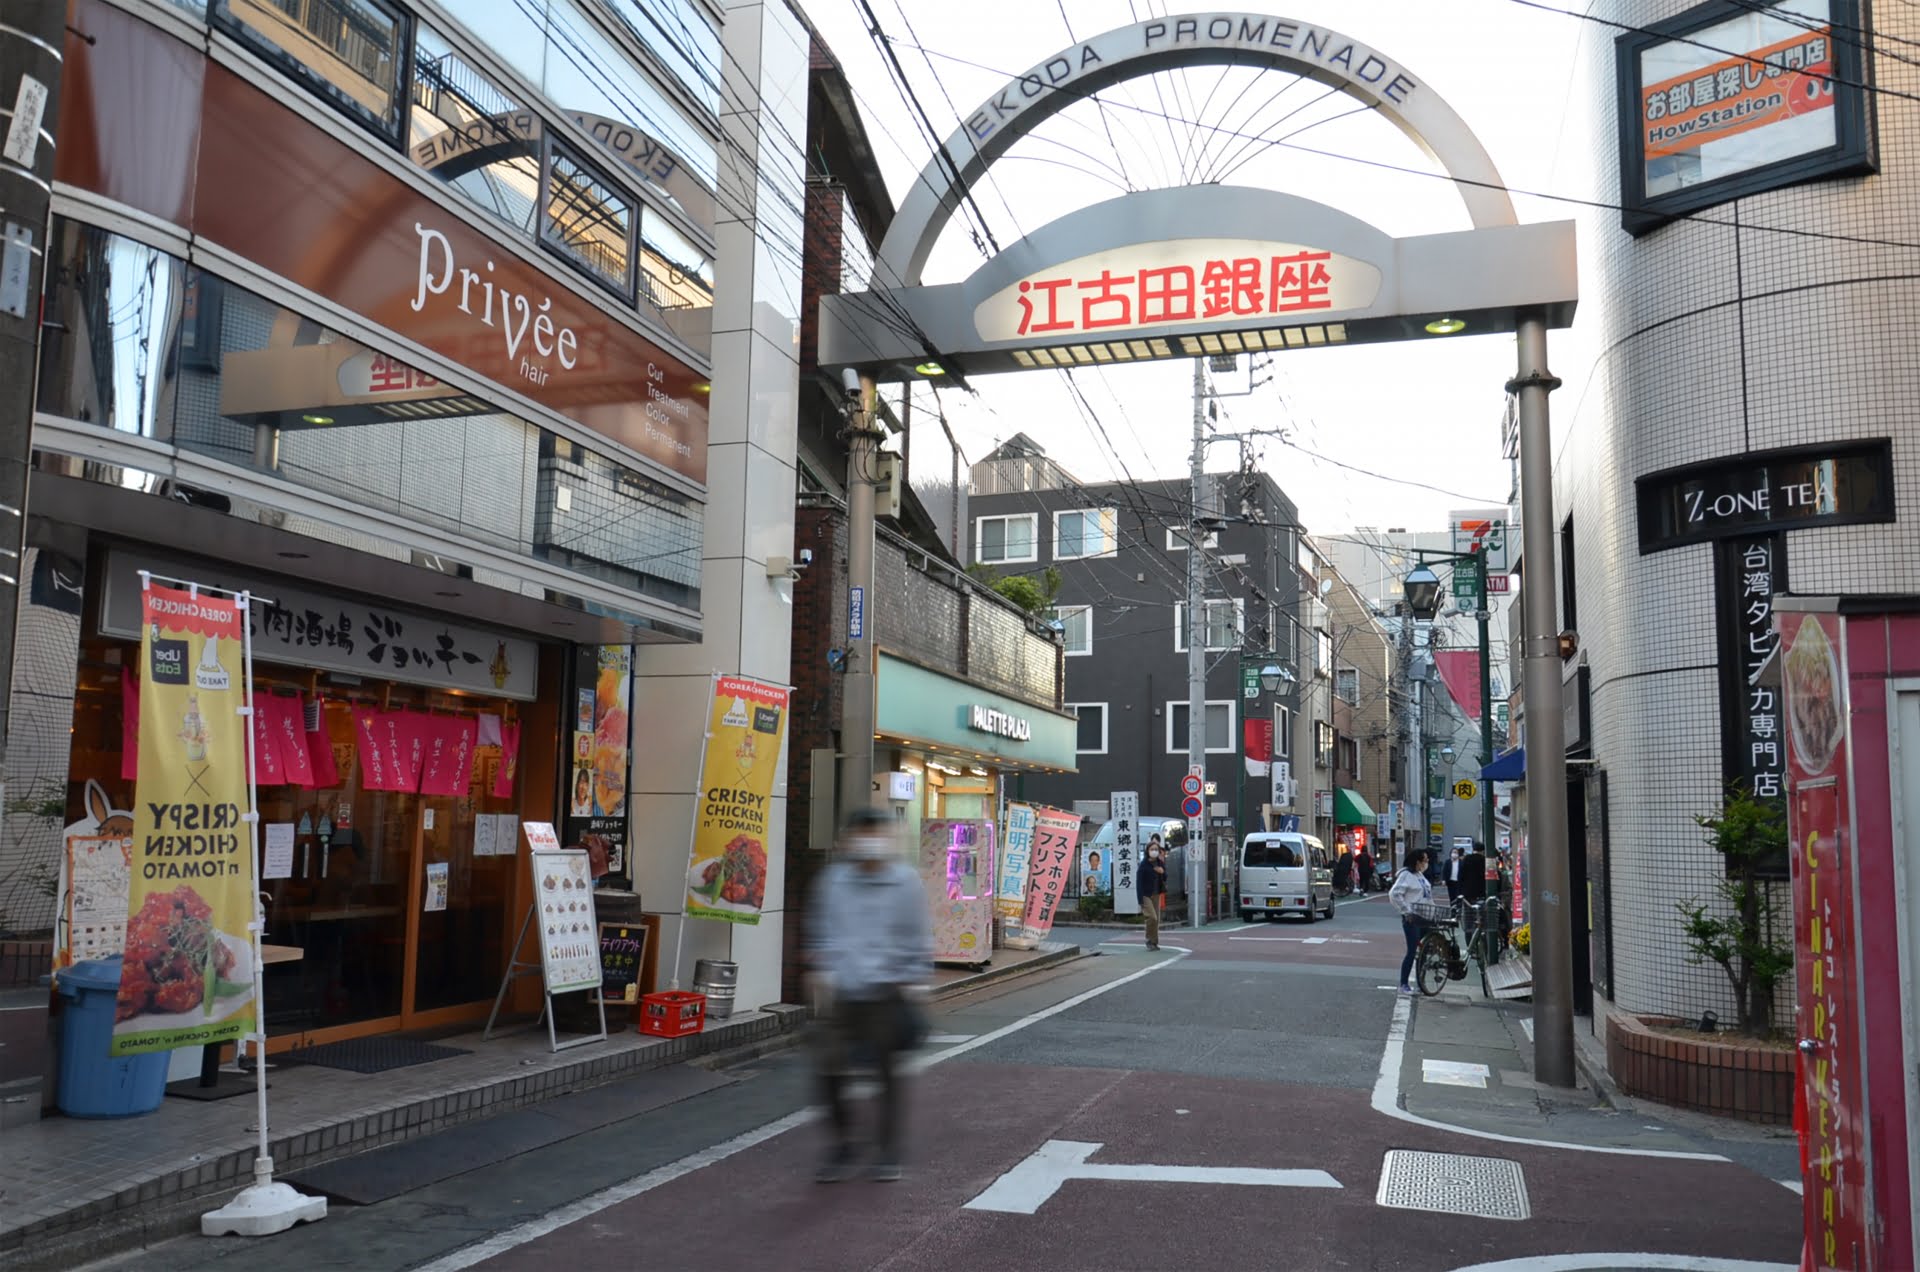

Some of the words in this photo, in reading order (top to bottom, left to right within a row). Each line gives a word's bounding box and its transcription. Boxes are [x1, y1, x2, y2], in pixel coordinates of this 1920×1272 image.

[967, 44, 1102, 141] EKODA
[1143, 17, 1418, 104] PROMENADE
[1645, 37, 1827, 122] お部屋探し専門店
[1647, 92, 1784, 143] HowStation
[1016, 251, 1333, 336] 江古田銀座
[519, 357, 552, 388] hair
[646, 362, 664, 383] Cut
[645, 403, 671, 427] Color
[646, 382, 690, 419] Treatment
[644, 422, 692, 459] Permanent
[1684, 488, 1771, 523] Z-ONE
[1780, 481, 1836, 508] TEA
[723, 681, 753, 694] KOREA
[974, 704, 1008, 737] PALETTE
[1008, 714, 1031, 741] PLAZA
[1263, 720, 1273, 752] TOKYO
[707, 788, 765, 808] CRISPY
[1186, 780, 1198, 790] 30
[1458, 783, 1472, 797] 肉
[705, 804, 764, 823] CHICKEN
[718, 818, 764, 834] TOMATO
[1002, 809, 1030, 898] 証明写真
[1117, 819, 1133, 889] 東郷堂薬局
[1039, 836, 1069, 921] スマホの写真
[600, 937, 641, 953] テイクアウト
